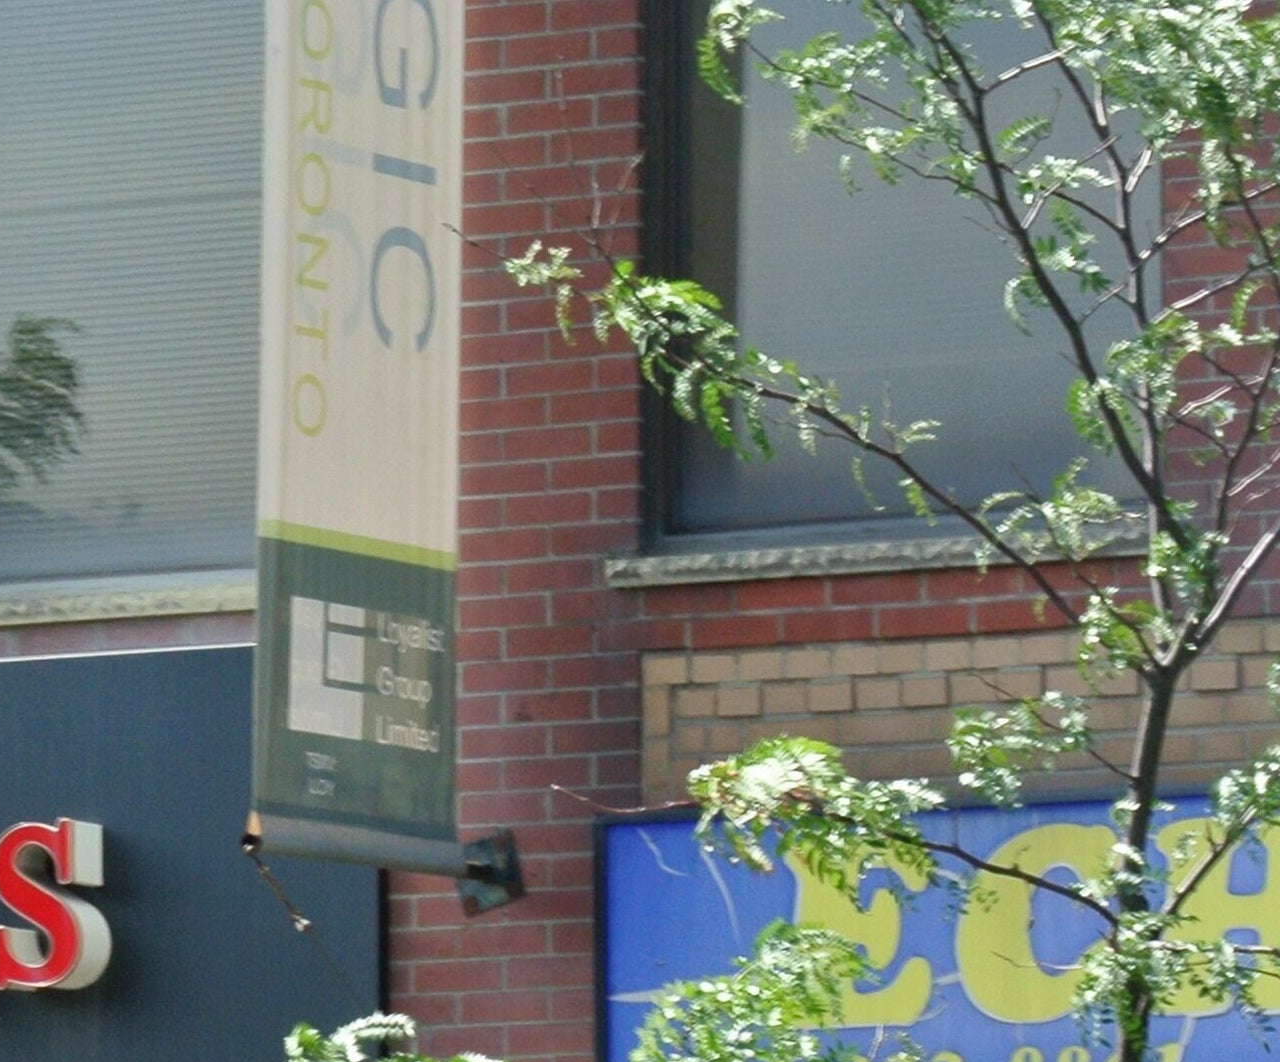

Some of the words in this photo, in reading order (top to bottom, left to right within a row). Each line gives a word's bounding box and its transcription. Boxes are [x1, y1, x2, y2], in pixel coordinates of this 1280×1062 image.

[371, 0, 438, 353] GIC
[375, 665, 433, 709] Group
[375, 714, 440, 753] Limited
